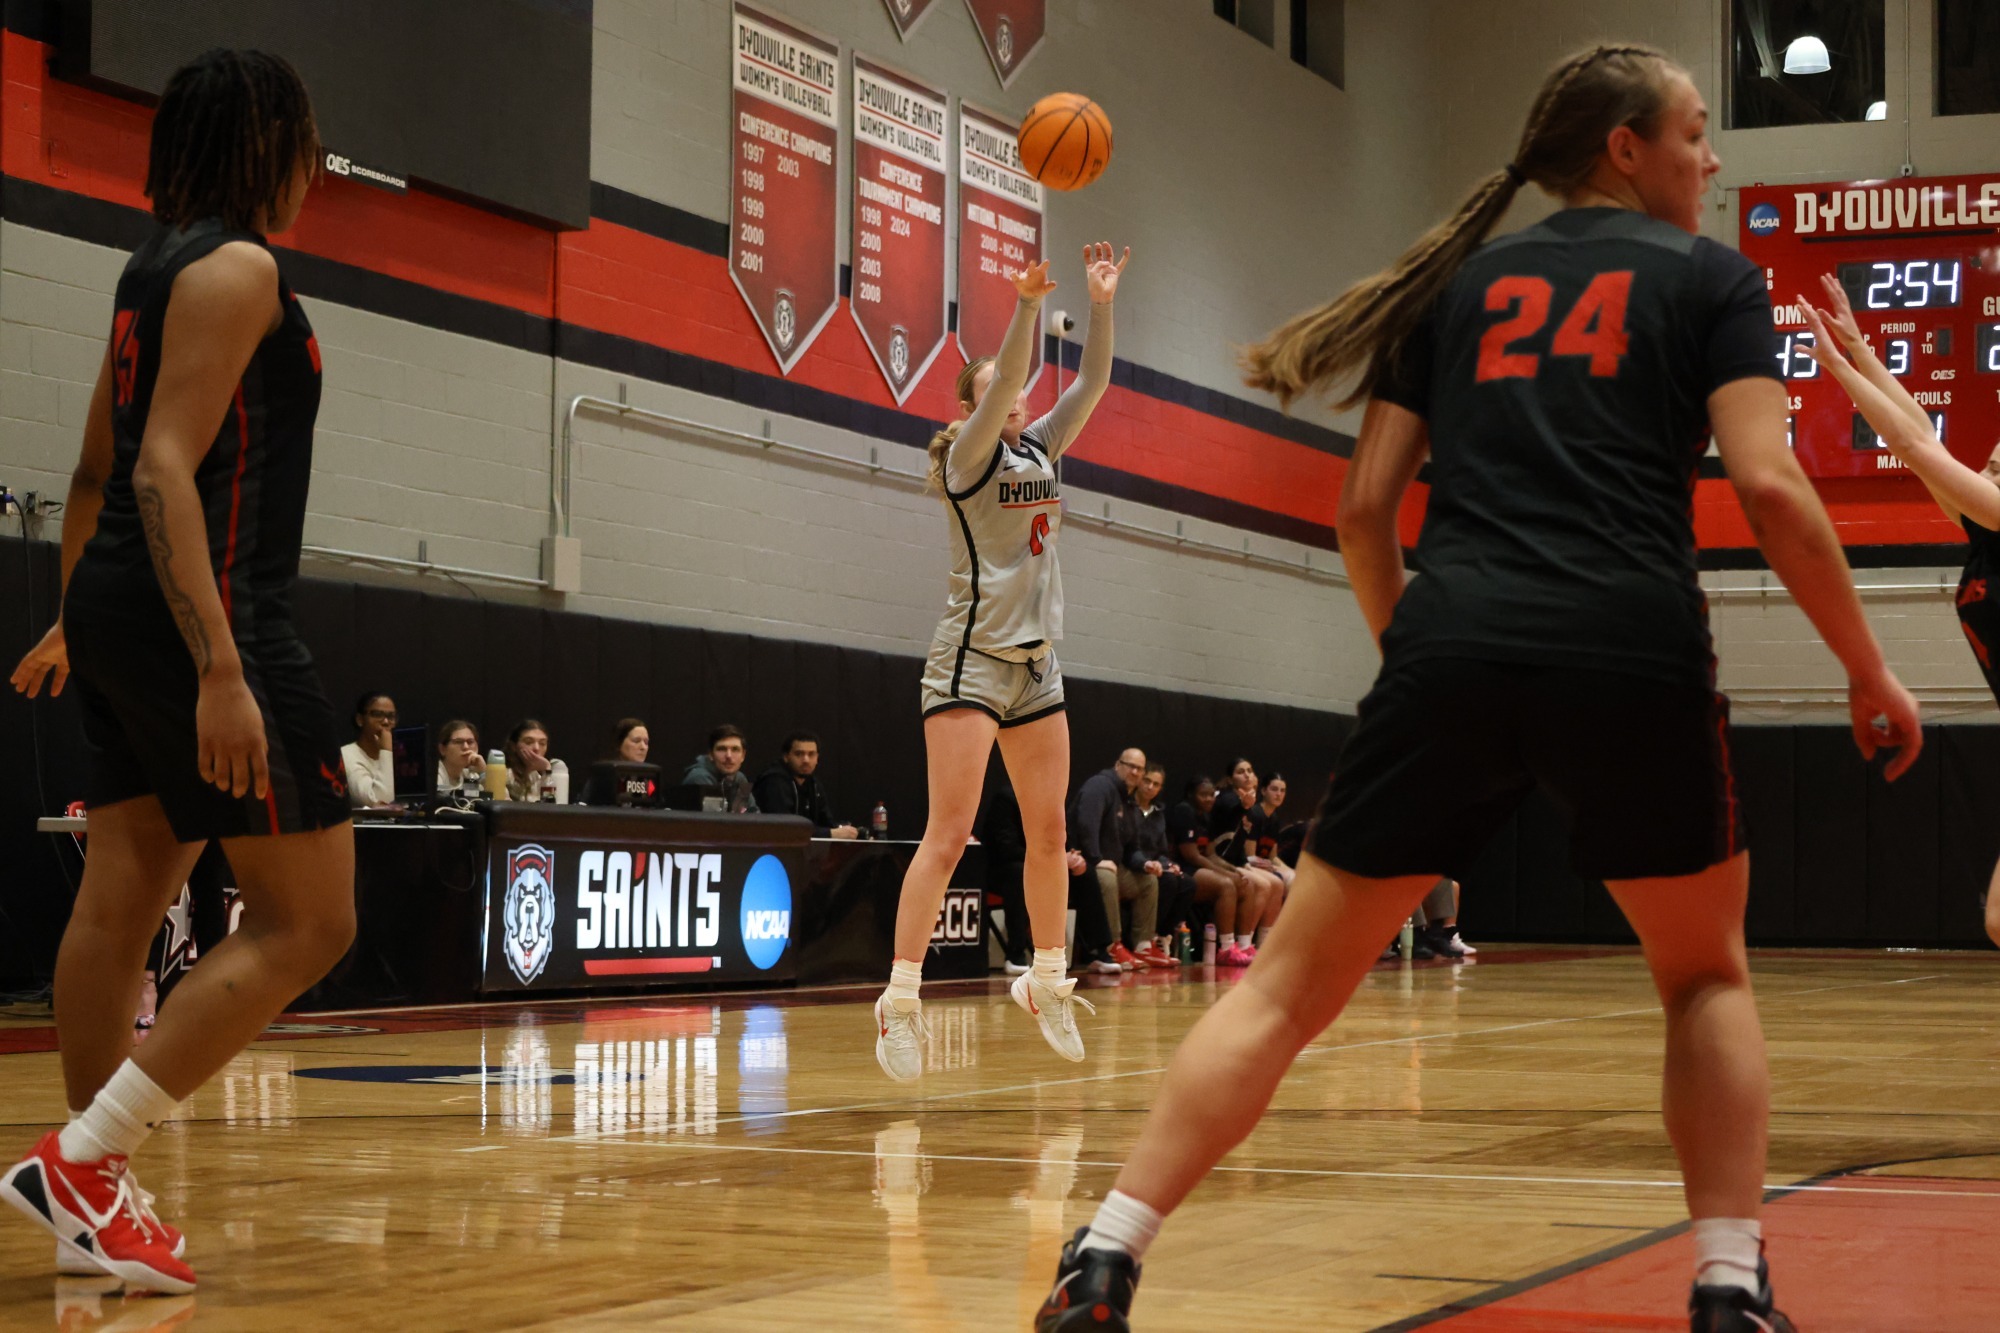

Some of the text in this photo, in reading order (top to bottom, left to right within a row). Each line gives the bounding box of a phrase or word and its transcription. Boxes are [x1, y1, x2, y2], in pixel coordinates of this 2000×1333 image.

[740, 62, 832, 118] WOMEN'S VOLLEYBALL
[740, 112, 832, 166] CONFERENCE CHAMPIONS
[860, 114, 941, 163] WOMEN'S VOLLEYBALL
[326, 153, 406, 188] OES SCOREBOARDS
[742, 141, 800, 178] 1997 2003
[742, 169, 765, 192] 1998
[879, 160, 922, 193] CONFERENCE
[965, 158, 1039, 203] WOMEN'S VOLLEYBALL
[858, 177, 904, 211] TOURNAMENT
[741, 196, 764, 219] 1999
[740, 223, 764, 246] 2000
[890, 216, 910, 238] 2024
[1749, 217, 1780, 229] NCAA
[860, 230, 881, 252] 2000
[1003, 242, 1024, 263] NCAA
[740, 250, 764, 273] 2001
[860, 256, 881, 279] 2003
[860, 282, 881, 304] 2008
[1867, 260, 1960, 308] 2:54
[1475, 269, 1635, 384] 24
[1881, 322, 1916, 334] PERIOD
[1890, 340, 1908, 374] 3
[1931, 369, 1956, 380] OES
[1913, 391, 1952, 405] FOULS
[576, 850, 722, 949] SAINTS
[745, 910, 790, 940] NCAA
